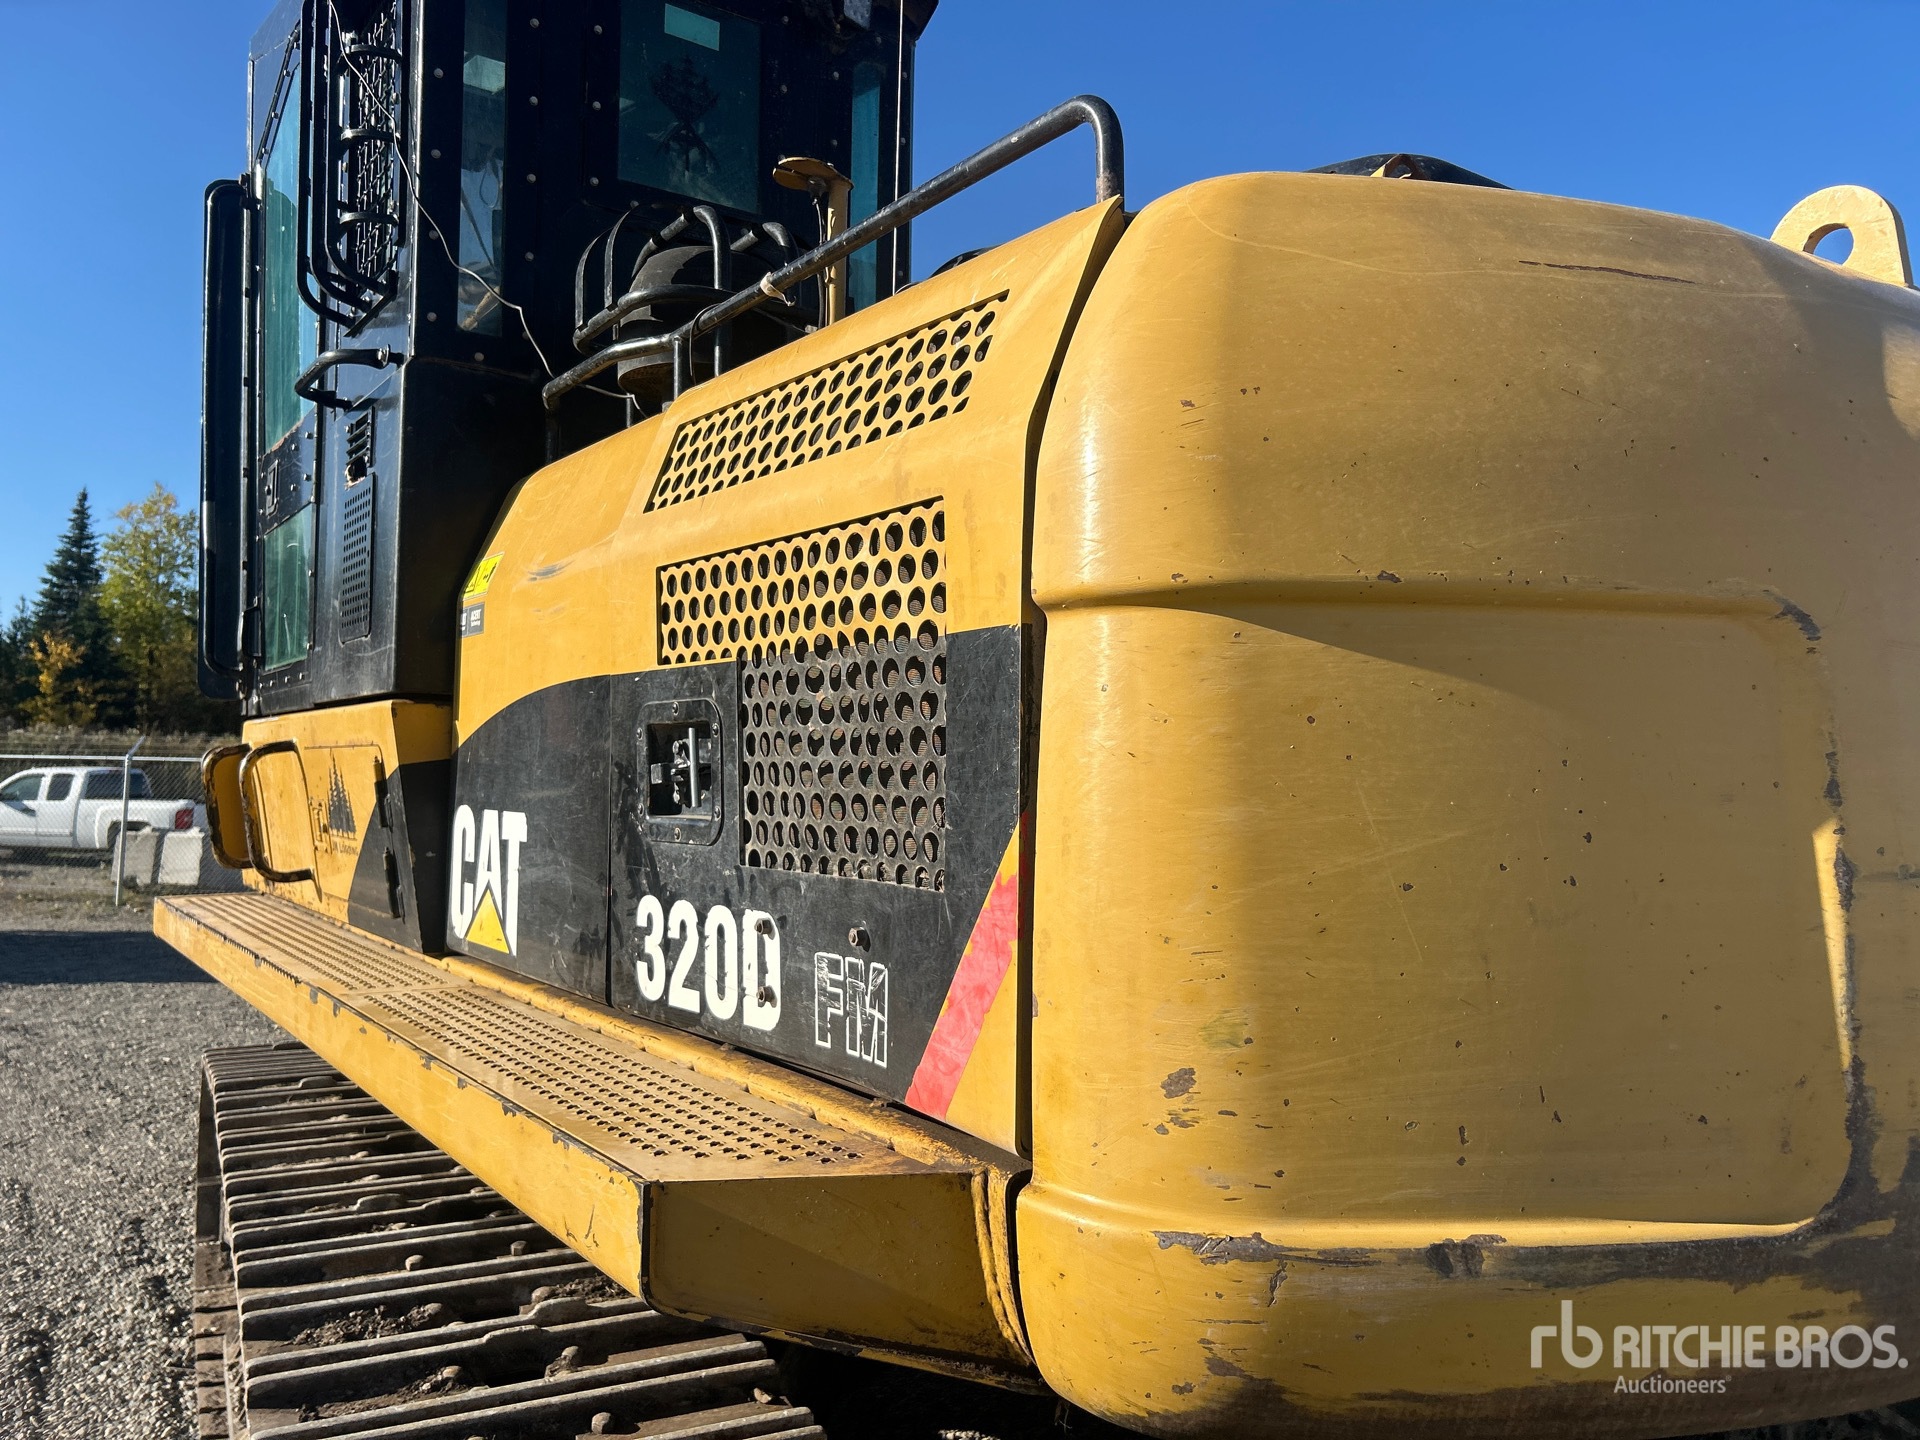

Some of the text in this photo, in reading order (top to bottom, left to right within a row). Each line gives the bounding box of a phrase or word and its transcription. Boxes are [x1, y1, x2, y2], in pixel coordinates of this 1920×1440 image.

[450, 803, 528, 956] CAT
[635, 894, 889, 1069] 320D FM
